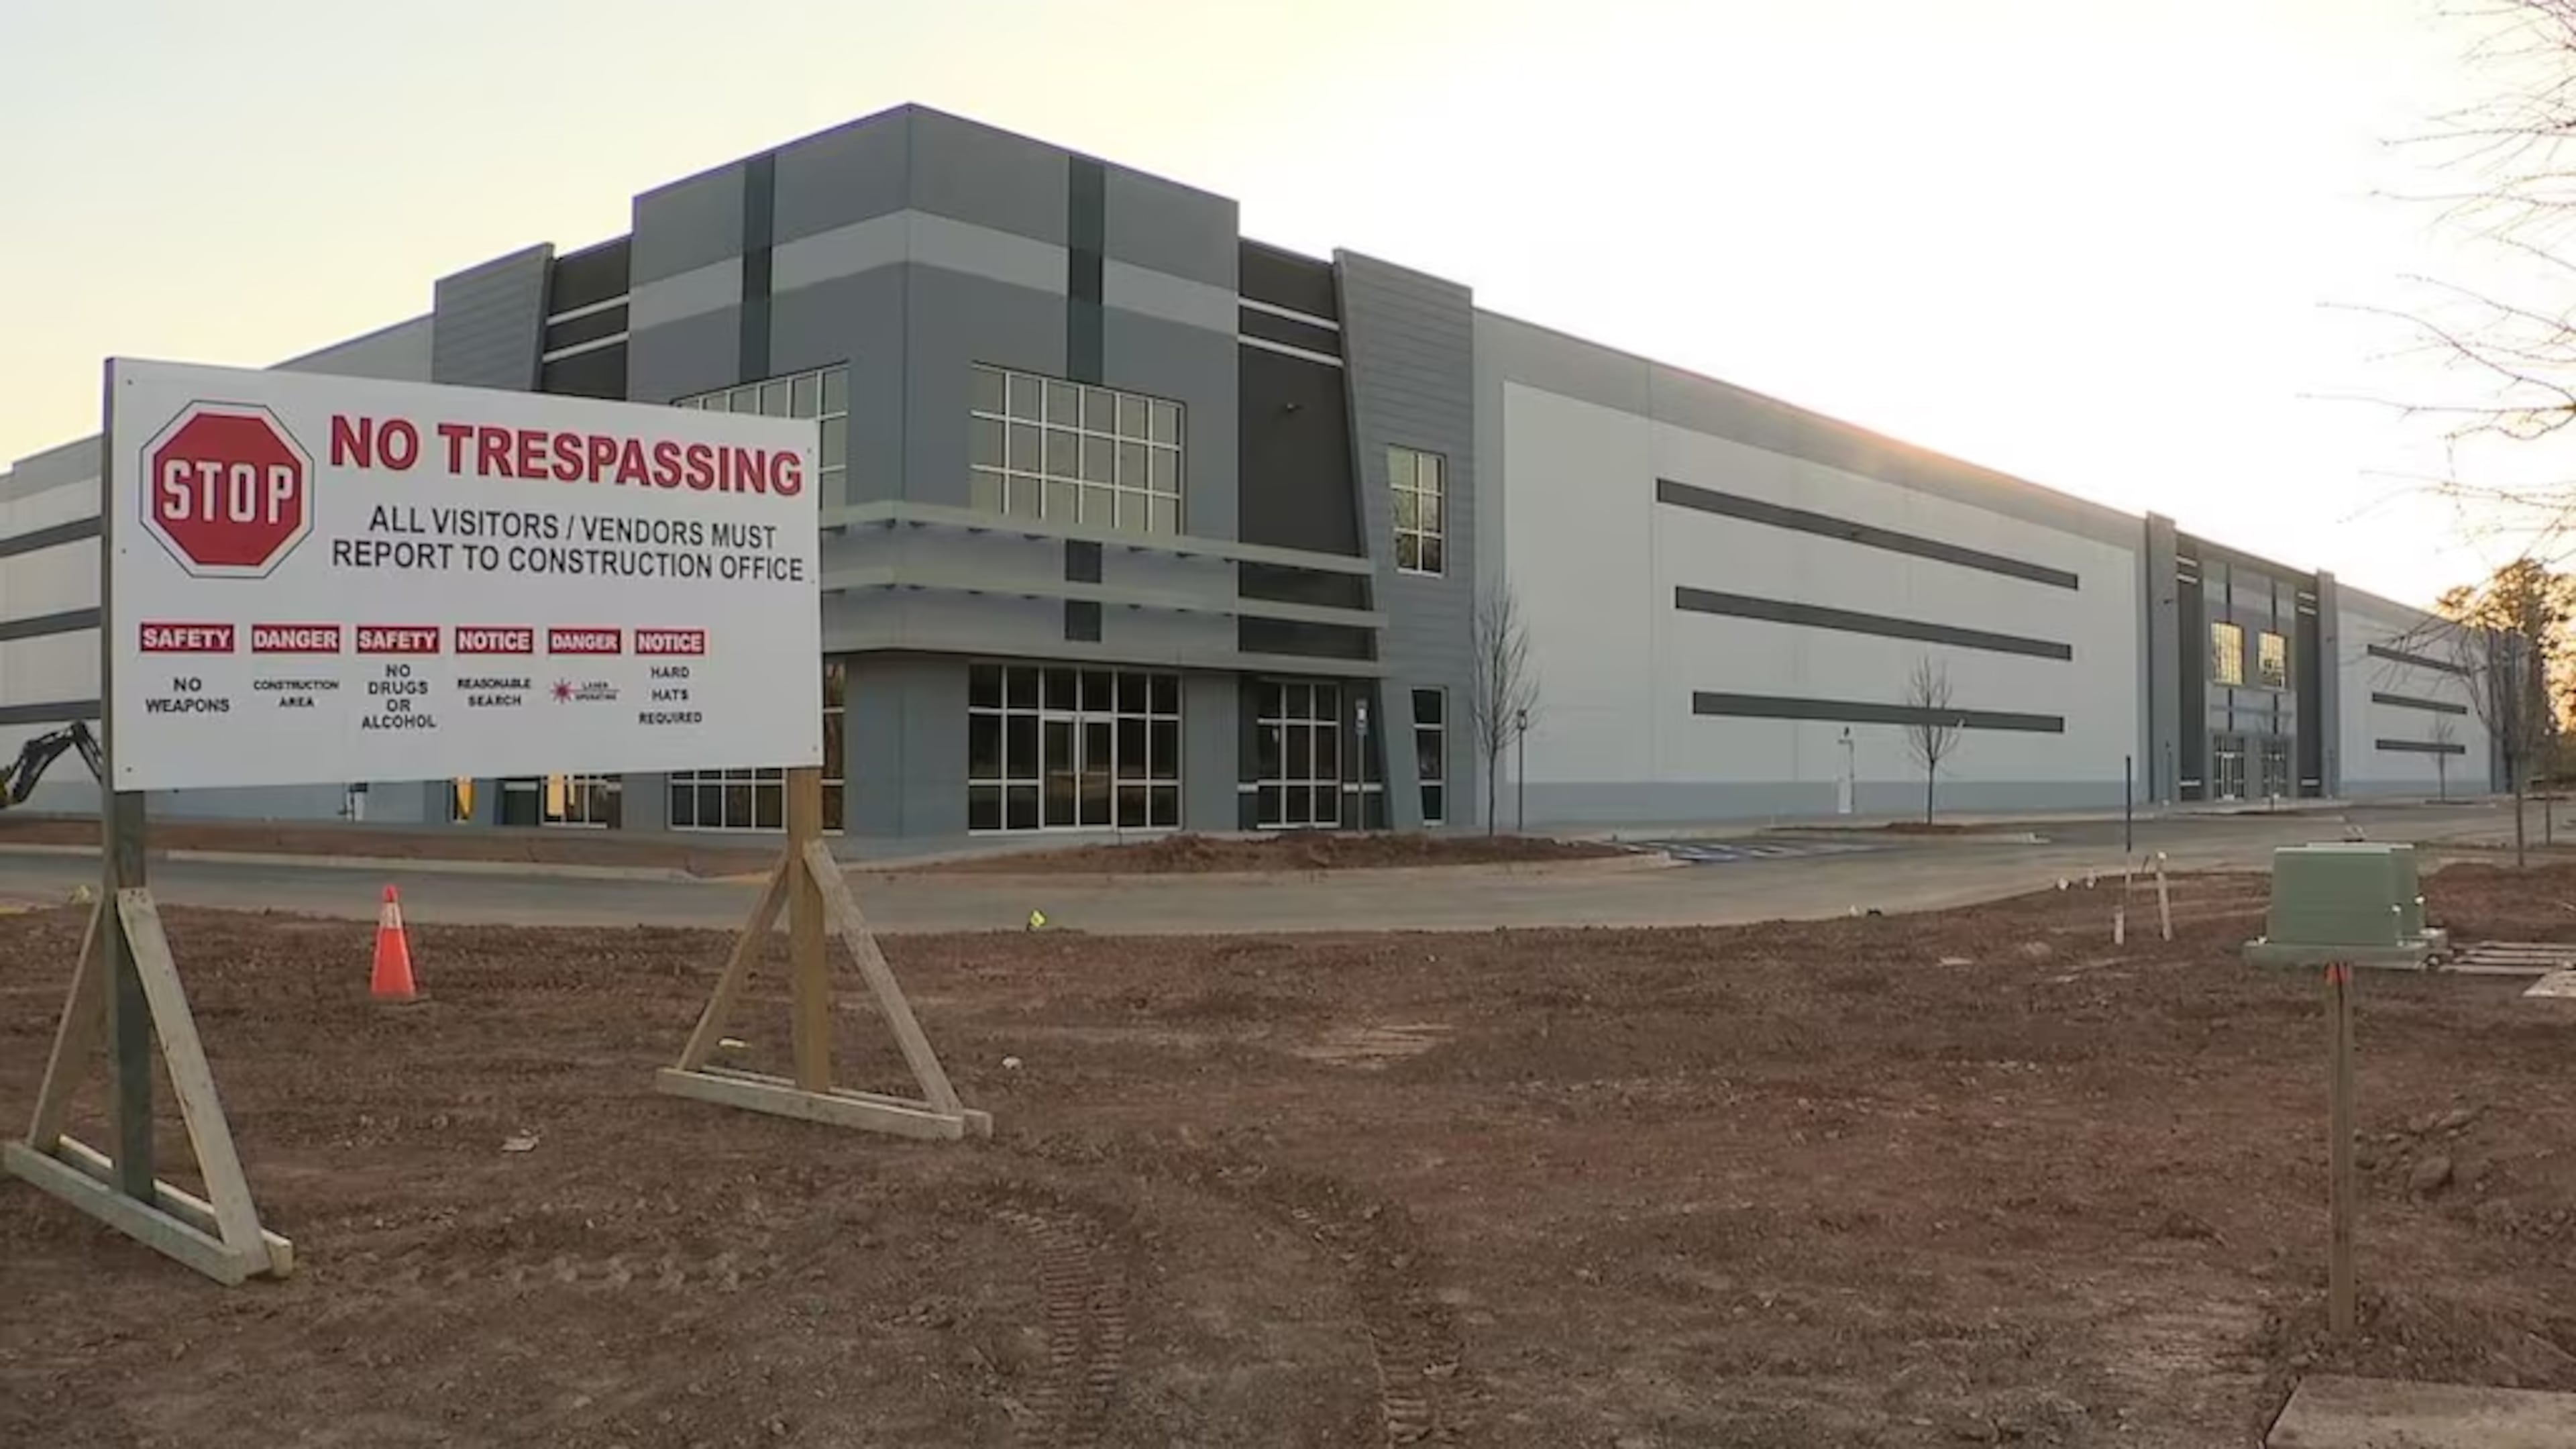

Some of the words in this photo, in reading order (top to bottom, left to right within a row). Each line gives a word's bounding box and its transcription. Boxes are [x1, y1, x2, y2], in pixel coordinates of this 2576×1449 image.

[330, 415, 419, 471] NO
[438, 423, 803, 497] TRESPASSING
[162, 459, 294, 524] STOP
[369, 506, 425, 534] ALL
[432, 508, 558, 540] VISITORS
[566, 512, 575, 540] /
[582, 516, 703, 547] VENDORS
[712, 523, 776, 549] MUST
[333, 540, 453, 570] REPORT
[462, 545, 499, 572] TO
[509, 547, 711, 579] CONSTRUCTION
[720, 555, 804, 582] OFFICE
[143, 627, 231, 648] SAFETY
[254, 629, 338, 649] DANGER
[359, 630, 437, 649] SAFETY
[458, 631, 531, 651] NOTICE
[551, 632, 618, 650] DANGER
[637, 633, 702, 652] NOTICE
[385, 664, 411, 677] NO
[651, 667, 690, 678] HARD
[174, 678, 201, 692] NO
[254, 680, 339, 690] CONSTRUCTION
[368, 682, 428, 695] DRUGS
[458, 678, 531, 690] REASONABLE
[468, 695, 522, 706] SEARCH
[652, 690, 689, 701] HATS
[146, 698, 229, 712] WEAPONS
[278, 698, 314, 708] AREA
[386, 698, 411, 712] OR
[362, 715, 437, 729] ALCOHOL
[639, 712, 702, 724] REQUIRED
